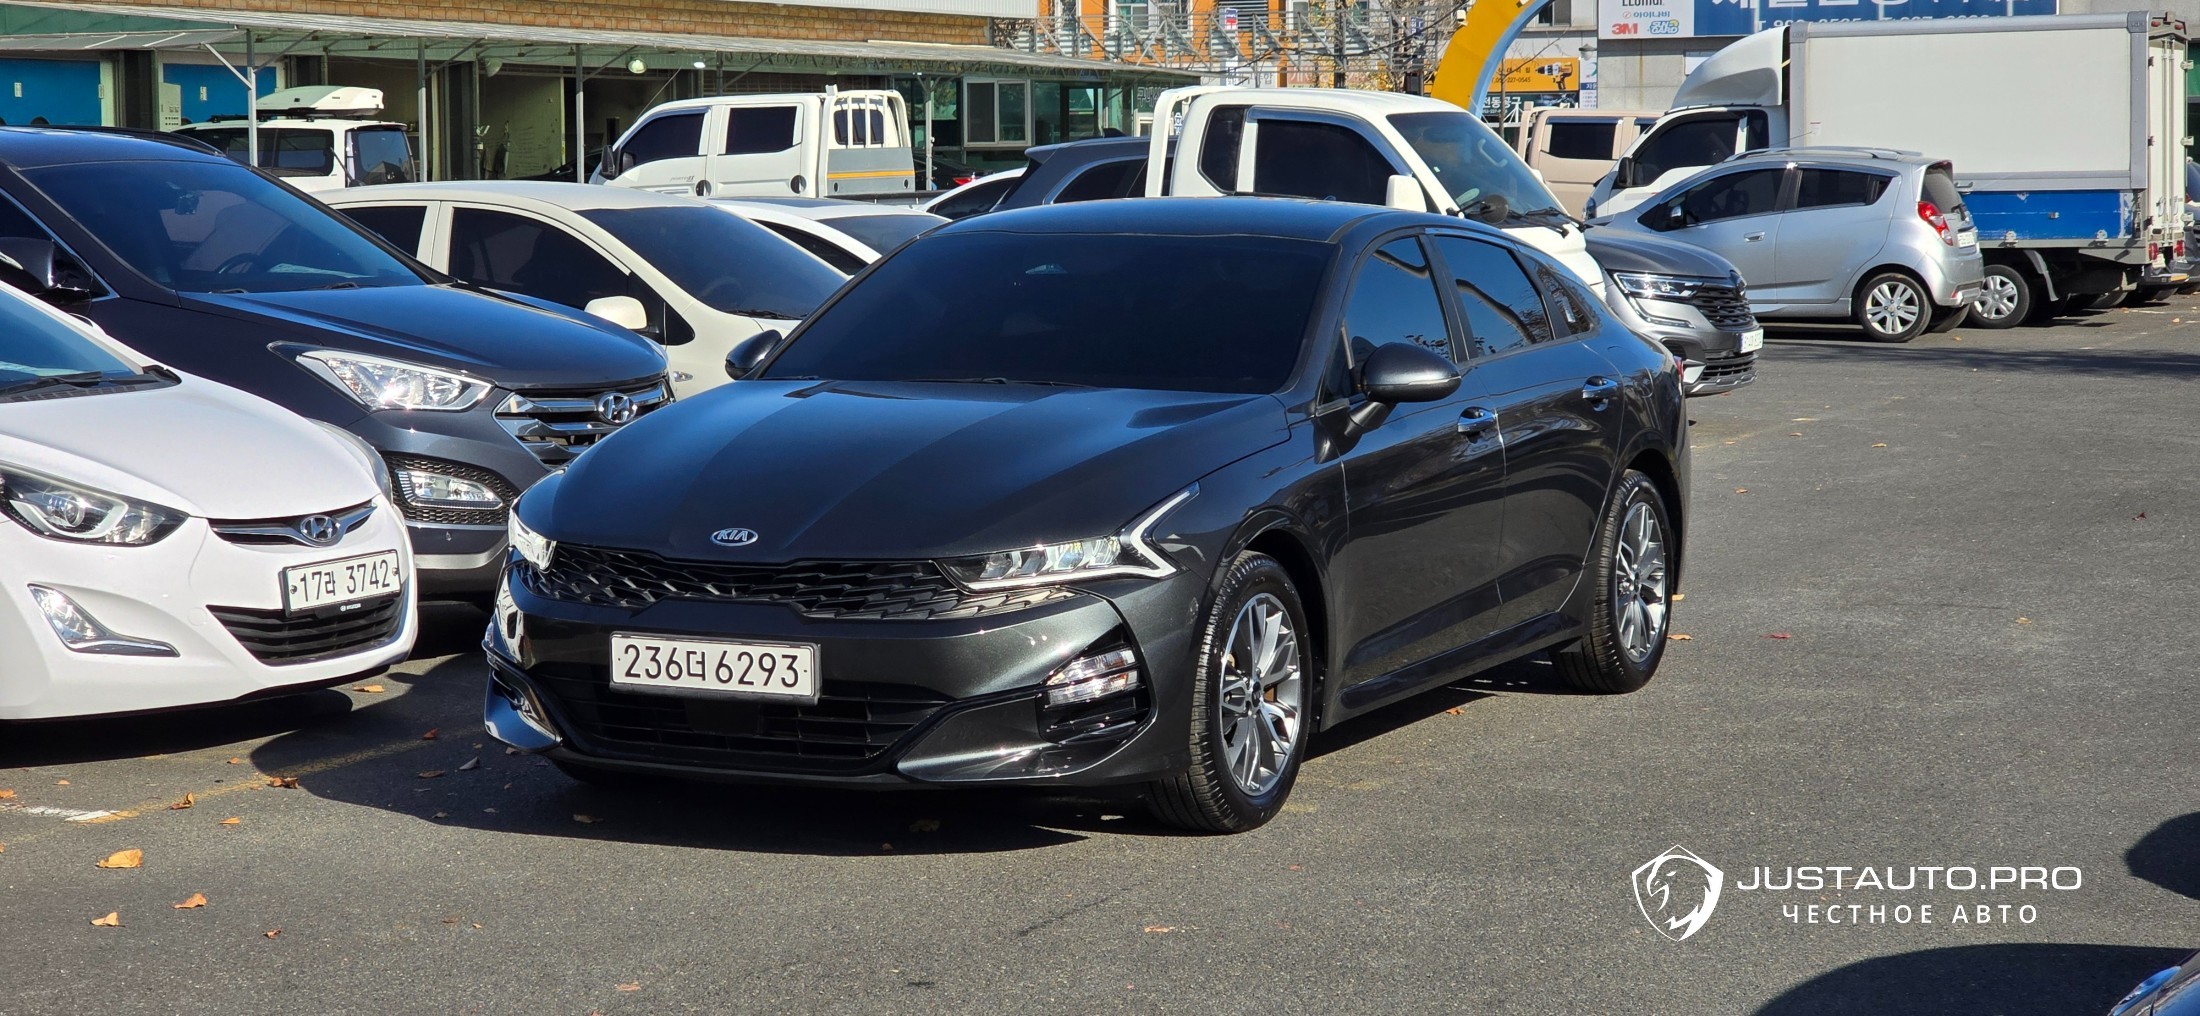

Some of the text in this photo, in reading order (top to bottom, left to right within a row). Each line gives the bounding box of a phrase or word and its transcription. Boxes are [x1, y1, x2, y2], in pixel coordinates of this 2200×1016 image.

[1611, 23, 1638, 34] 3M
[716, 529, 749, 541] KIA
[300, 559, 391, 602] 17라 3742
